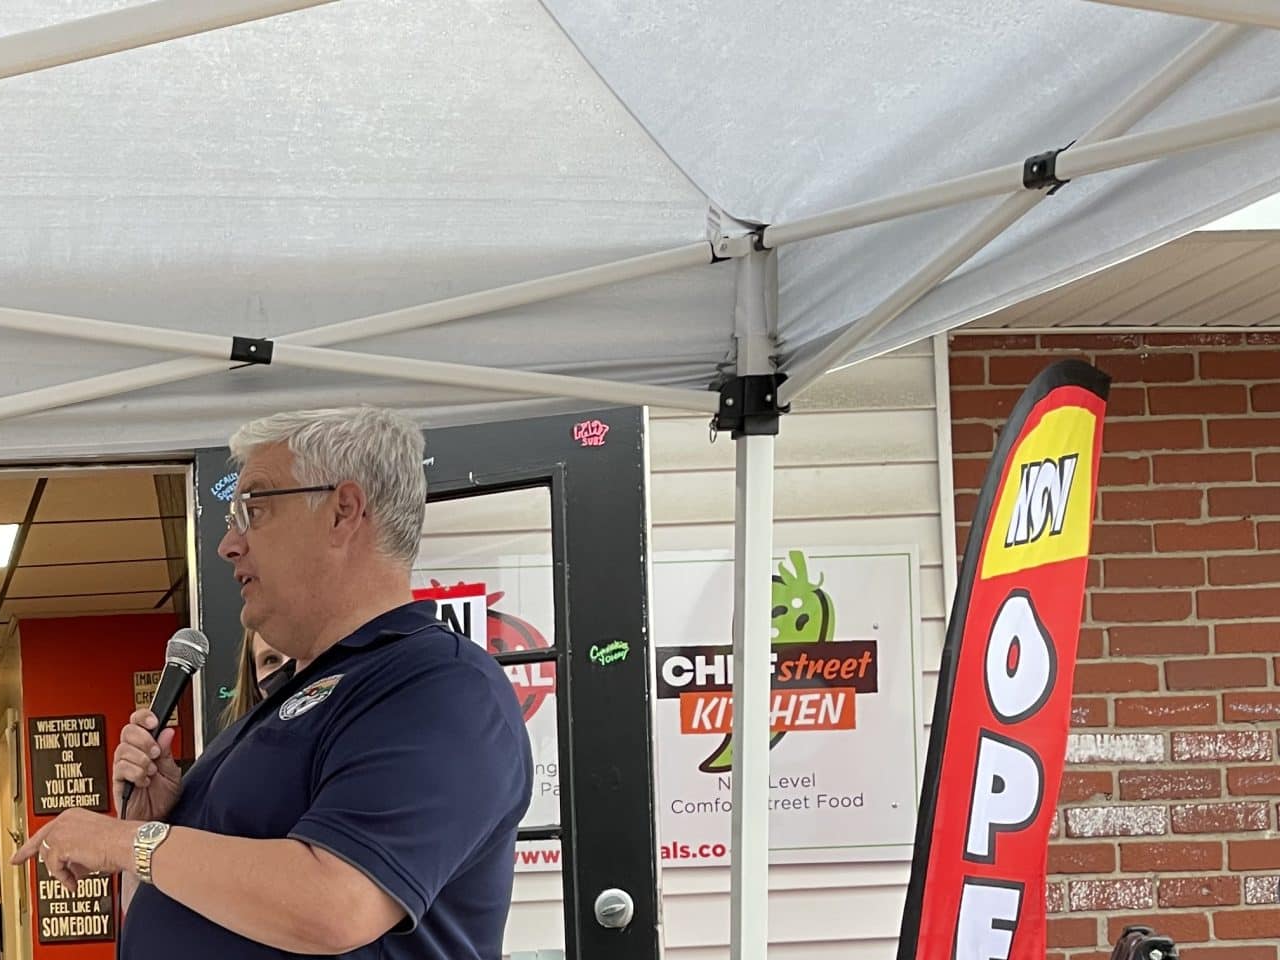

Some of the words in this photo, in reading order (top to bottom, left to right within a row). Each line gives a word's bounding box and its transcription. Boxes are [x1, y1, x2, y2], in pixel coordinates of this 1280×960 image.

[508, 662, 554, 687] AL
[662, 653, 777, 688] CH
[778, 651, 872, 682] street
[135, 672, 162, 686] IMAG
[135, 691, 156, 705] CRE
[692, 691, 846, 730] KIHEN
[36, 719, 78, 733] WHETHER
[78, 718, 96, 731] YOU
[34, 733, 61, 750] THINK
[62, 732, 81, 749] YOU
[82, 731, 100, 747] CAN
[62, 750, 74, 762] OR
[54, 762, 83, 779] THINK
[536, 763, 557, 779] ng
[45, 779, 65, 796] YOU
[67, 777, 94, 794] CAN'T
[541, 782, 560, 796] Pa
[768, 773, 816, 790] Level
[40, 796, 59, 809] YOU
[59, 795, 76, 808] ARE
[76, 793, 100, 806] RIGHT
[671, 797, 733, 814] Comfo
[768, 794, 810, 810] reet
[817, 793, 864, 809] Food
[514, 850, 560, 865] ww
[661, 841, 726, 859] als.co
[50, 902, 70, 914] FEEL
[72, 900, 91, 913] LIKE
[93, 900, 100, 913] A
[42, 914, 110, 937] SOMEBODY
